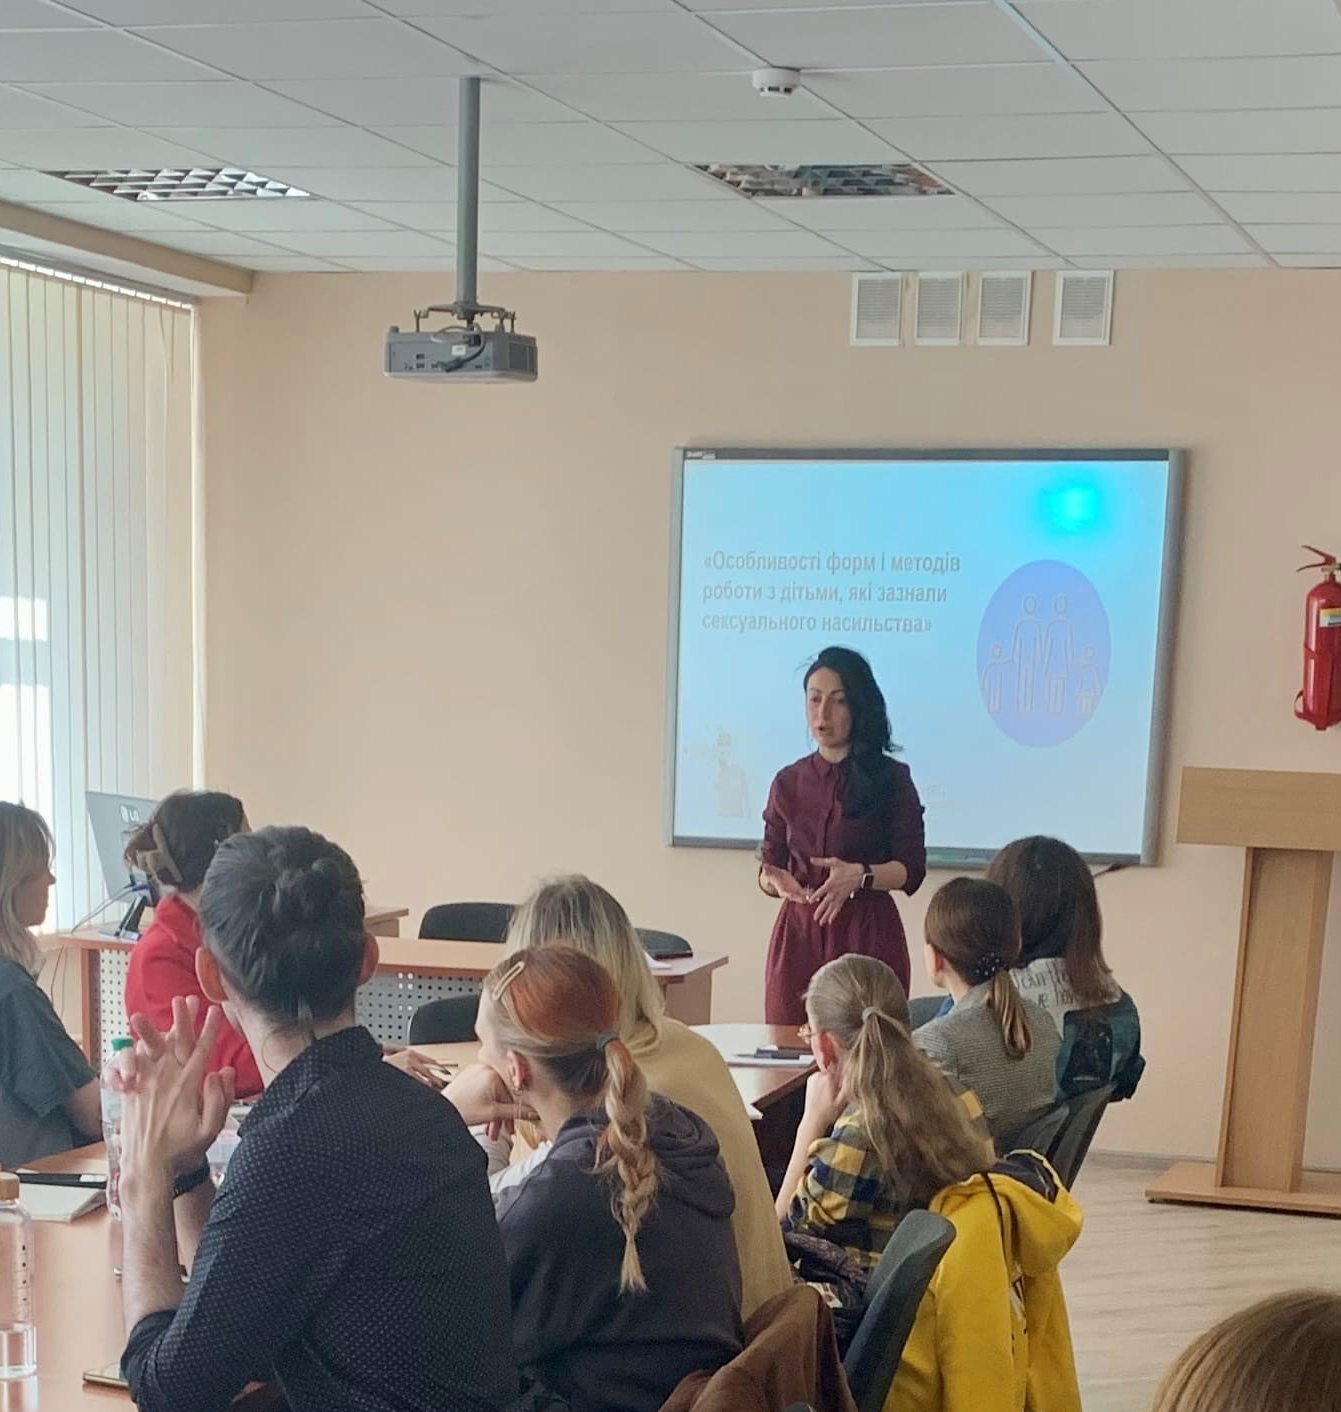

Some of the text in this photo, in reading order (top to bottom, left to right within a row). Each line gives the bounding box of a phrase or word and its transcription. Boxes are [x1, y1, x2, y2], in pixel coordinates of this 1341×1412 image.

[704, 550, 821, 571] «Особливості
[826, 551, 875, 575] форм
[891, 551, 961, 575] методів
[702, 580, 947, 604] роботи з дітьми, які зазнали
[701, 614, 932, 634] сексуального насильства»
